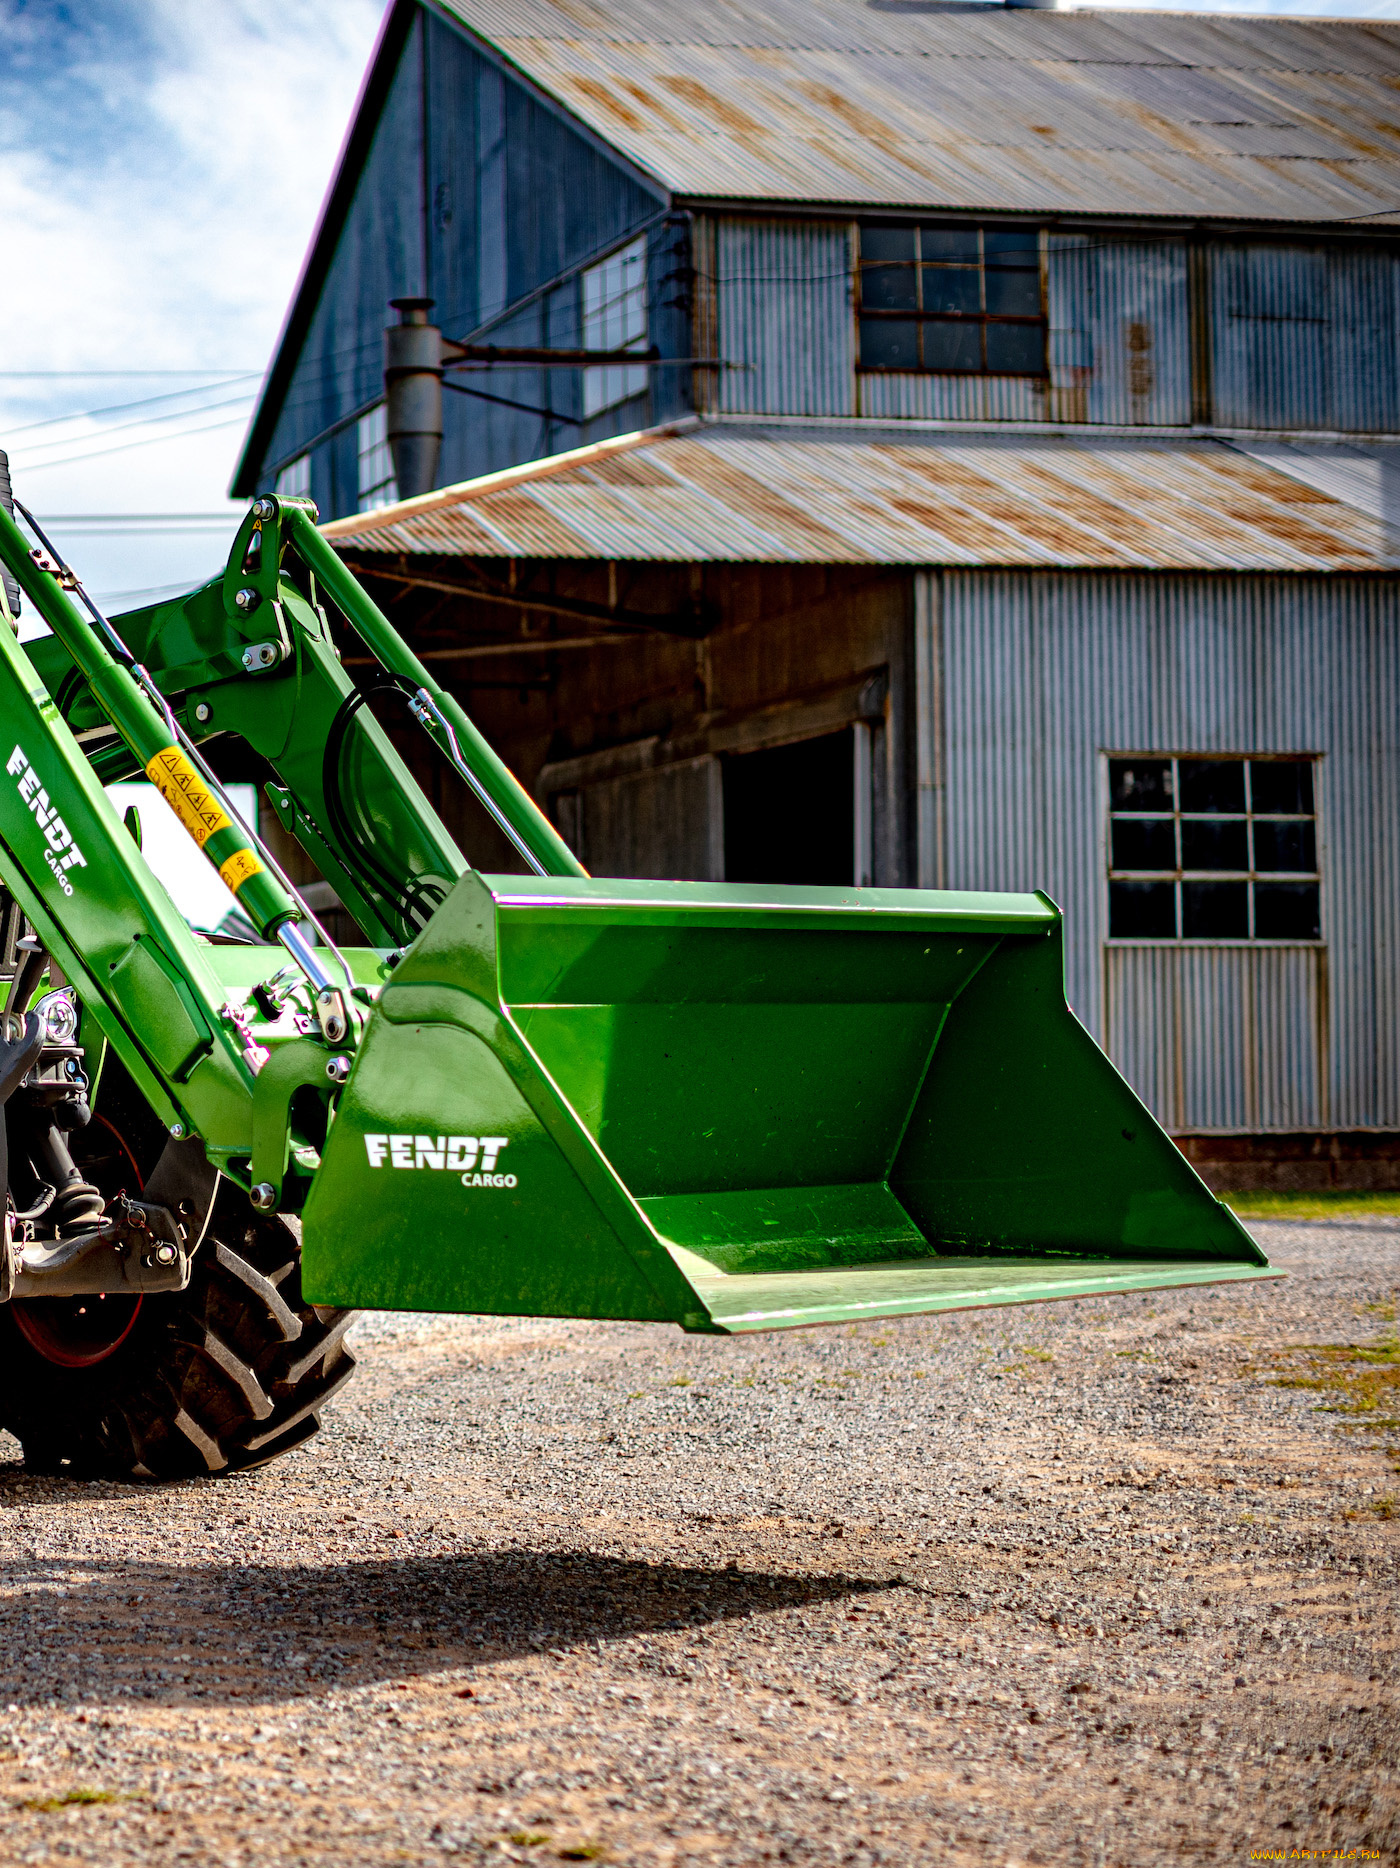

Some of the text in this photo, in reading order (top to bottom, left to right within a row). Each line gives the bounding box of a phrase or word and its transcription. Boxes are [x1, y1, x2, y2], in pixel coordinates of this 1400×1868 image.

[5, 744, 88, 871] FENDT
[43, 848, 75, 897] CARGO
[363, 1133, 509, 1171] FENDT
[461, 1172, 518, 1188] CARGO
